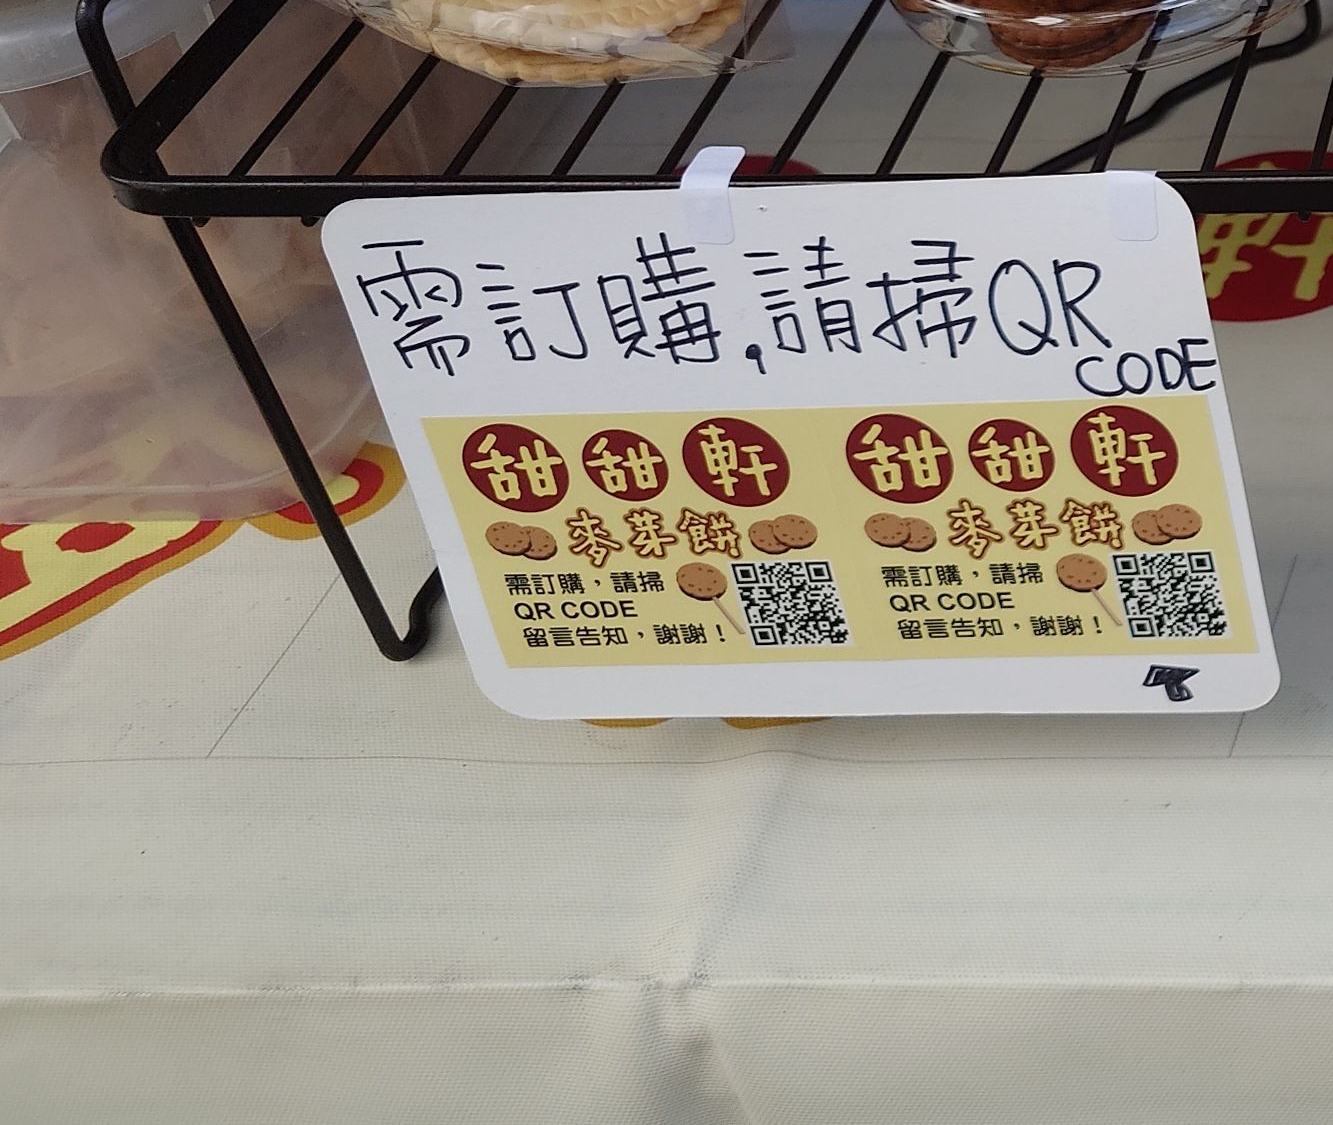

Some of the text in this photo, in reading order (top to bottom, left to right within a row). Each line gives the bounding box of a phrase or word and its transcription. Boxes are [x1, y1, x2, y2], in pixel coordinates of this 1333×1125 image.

[1075, 338, 1218, 397] CODE
[469, 424, 779, 501] 甜甜軒
[852, 411, 1167, 493] 甜甜軒
[565, 507, 744, 569] 麥芽餅
[946, 497, 1127, 561] 麥芽餅
[514, 600, 638, 621] QR CODE
[889, 592, 1015, 613] QR CODE
